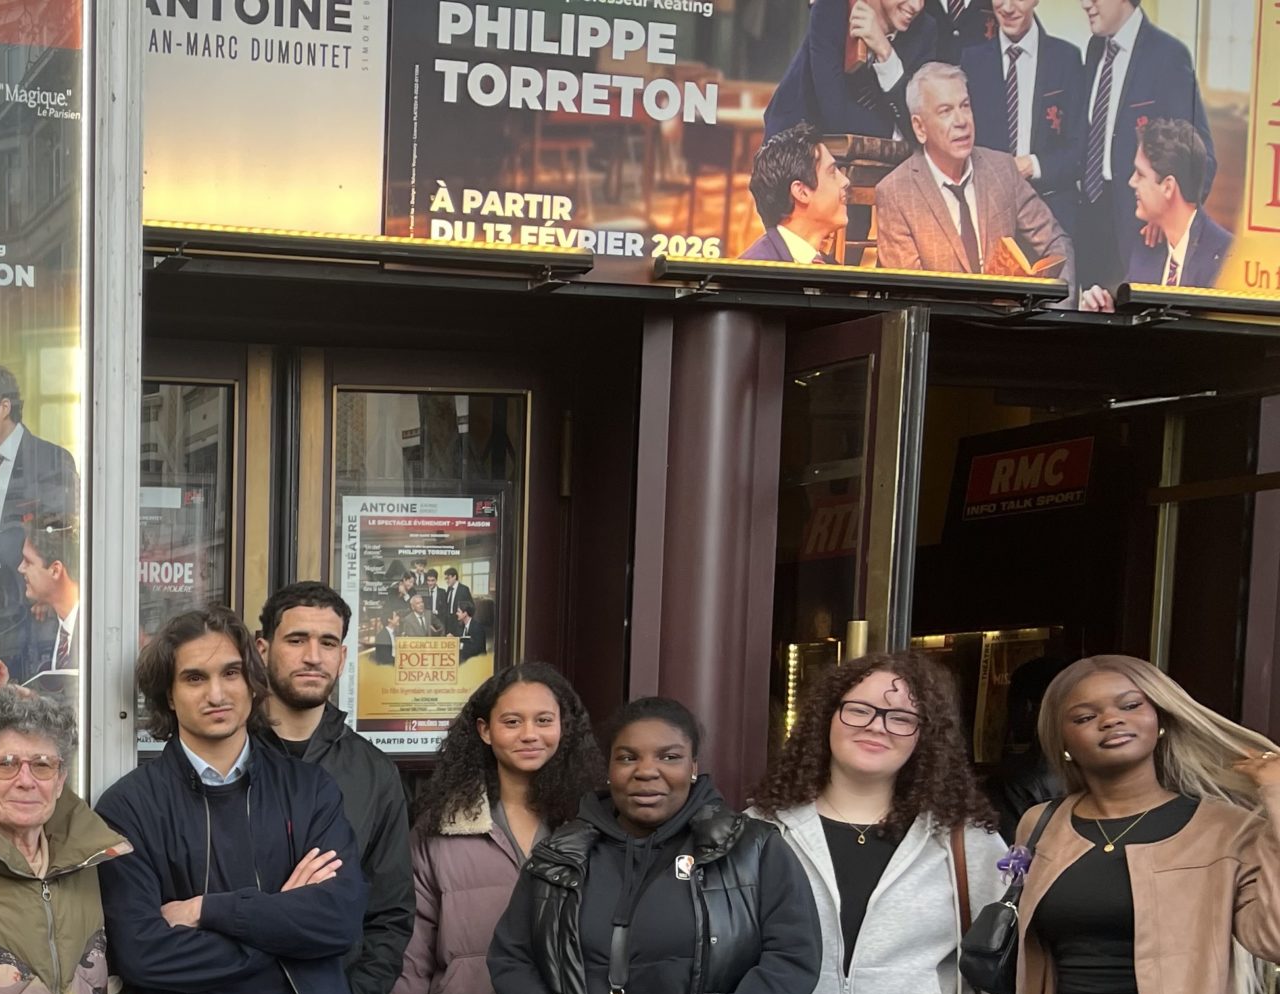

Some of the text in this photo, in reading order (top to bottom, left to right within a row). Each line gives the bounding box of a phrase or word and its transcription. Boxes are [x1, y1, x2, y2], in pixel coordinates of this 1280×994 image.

[438, 0, 677, 65] PHILIPPE
[251, 37, 352, 69] DUMONTET
[434, 58, 718, 125] TORRETON
[37, 107, 81, 120] Le Parisien
[430, 179, 572, 221] À PARTIR
[430, 219, 720, 259] DU 13 FÉVRIER 2026
[990, 448, 1069, 495] RMC
[360, 502, 418, 513] ANTOINE
[966, 490, 1084, 516] INFO TALK SPORT
[345, 515, 357, 580] THÉÂTRE
[138, 561, 194, 583] HROPE
[398, 670, 456, 682] DISPARUS
[431, 735, 443, 744] FÉ
